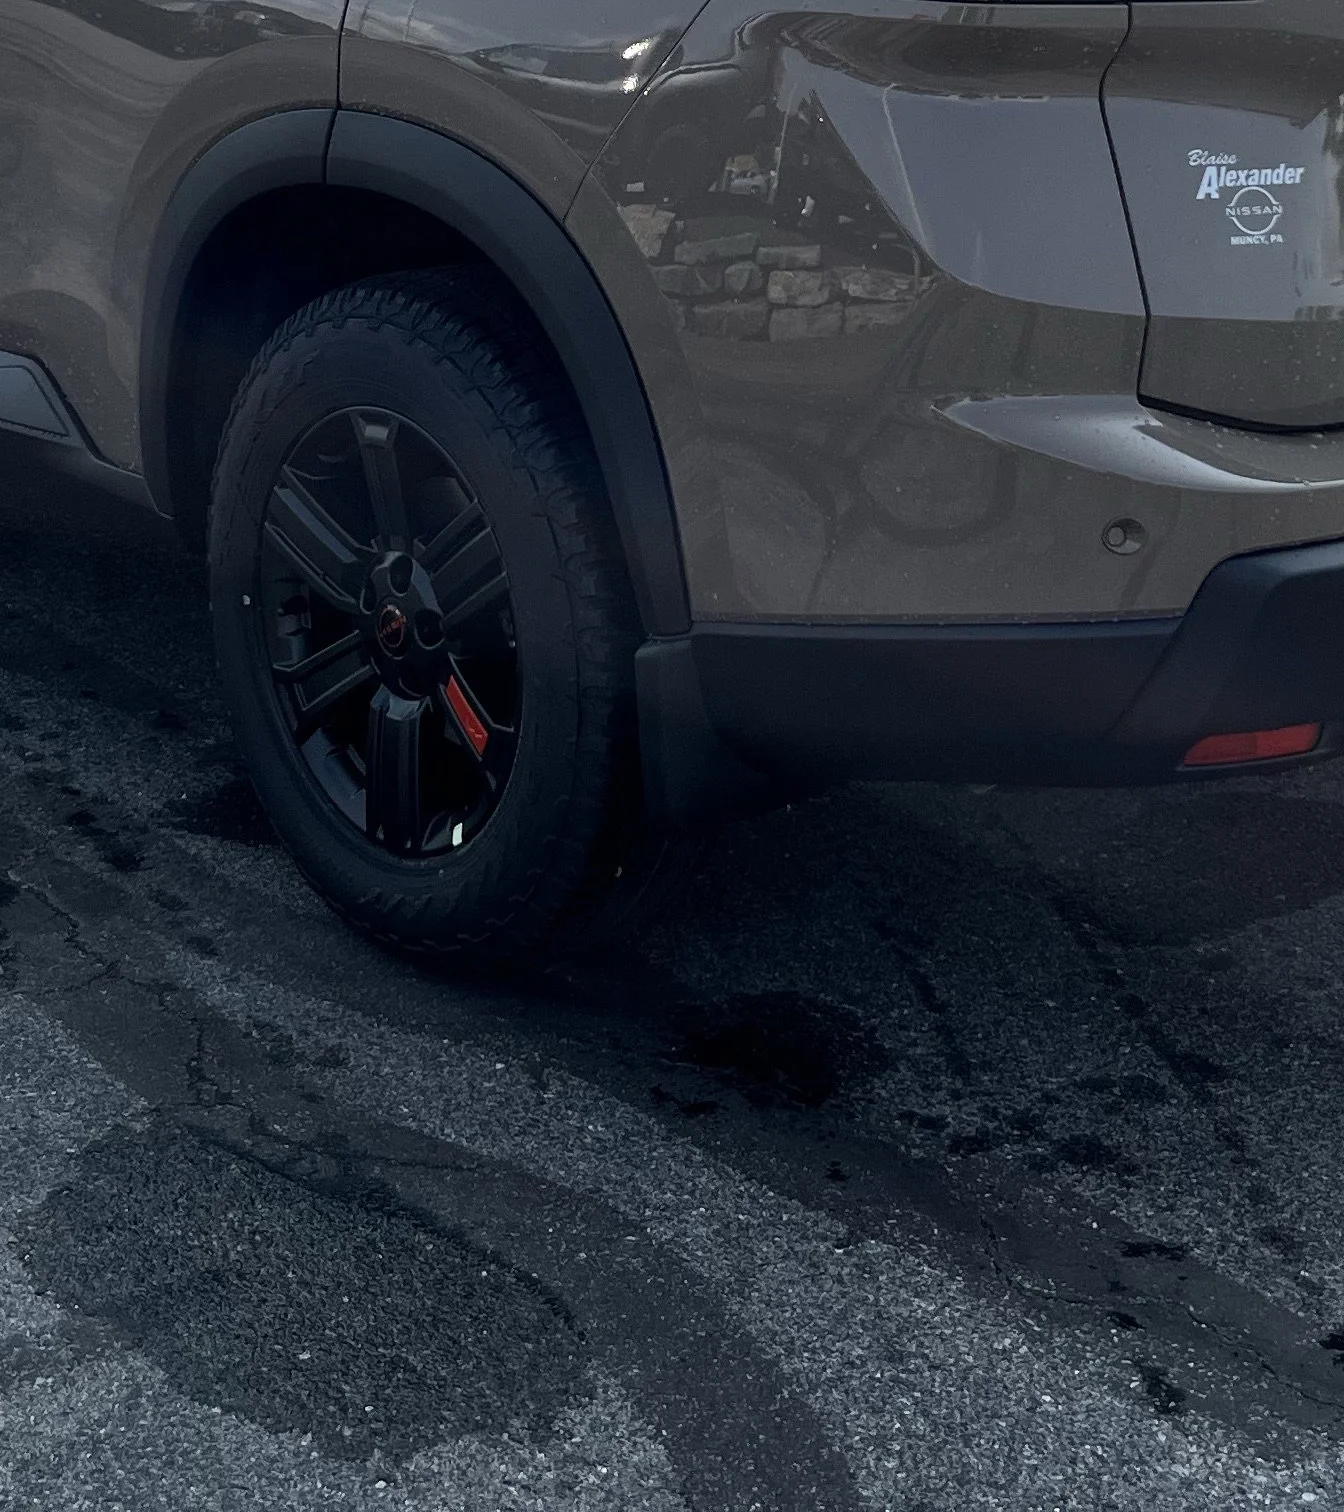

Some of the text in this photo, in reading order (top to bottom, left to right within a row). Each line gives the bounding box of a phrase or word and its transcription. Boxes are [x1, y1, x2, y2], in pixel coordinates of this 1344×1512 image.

[1187, 149, 1238, 166] Blaise
[1196, 163, 1305, 200] Alexander
[1225, 203, 1283, 217] NISSAN
[1271, 234, 1284, 243] PA
